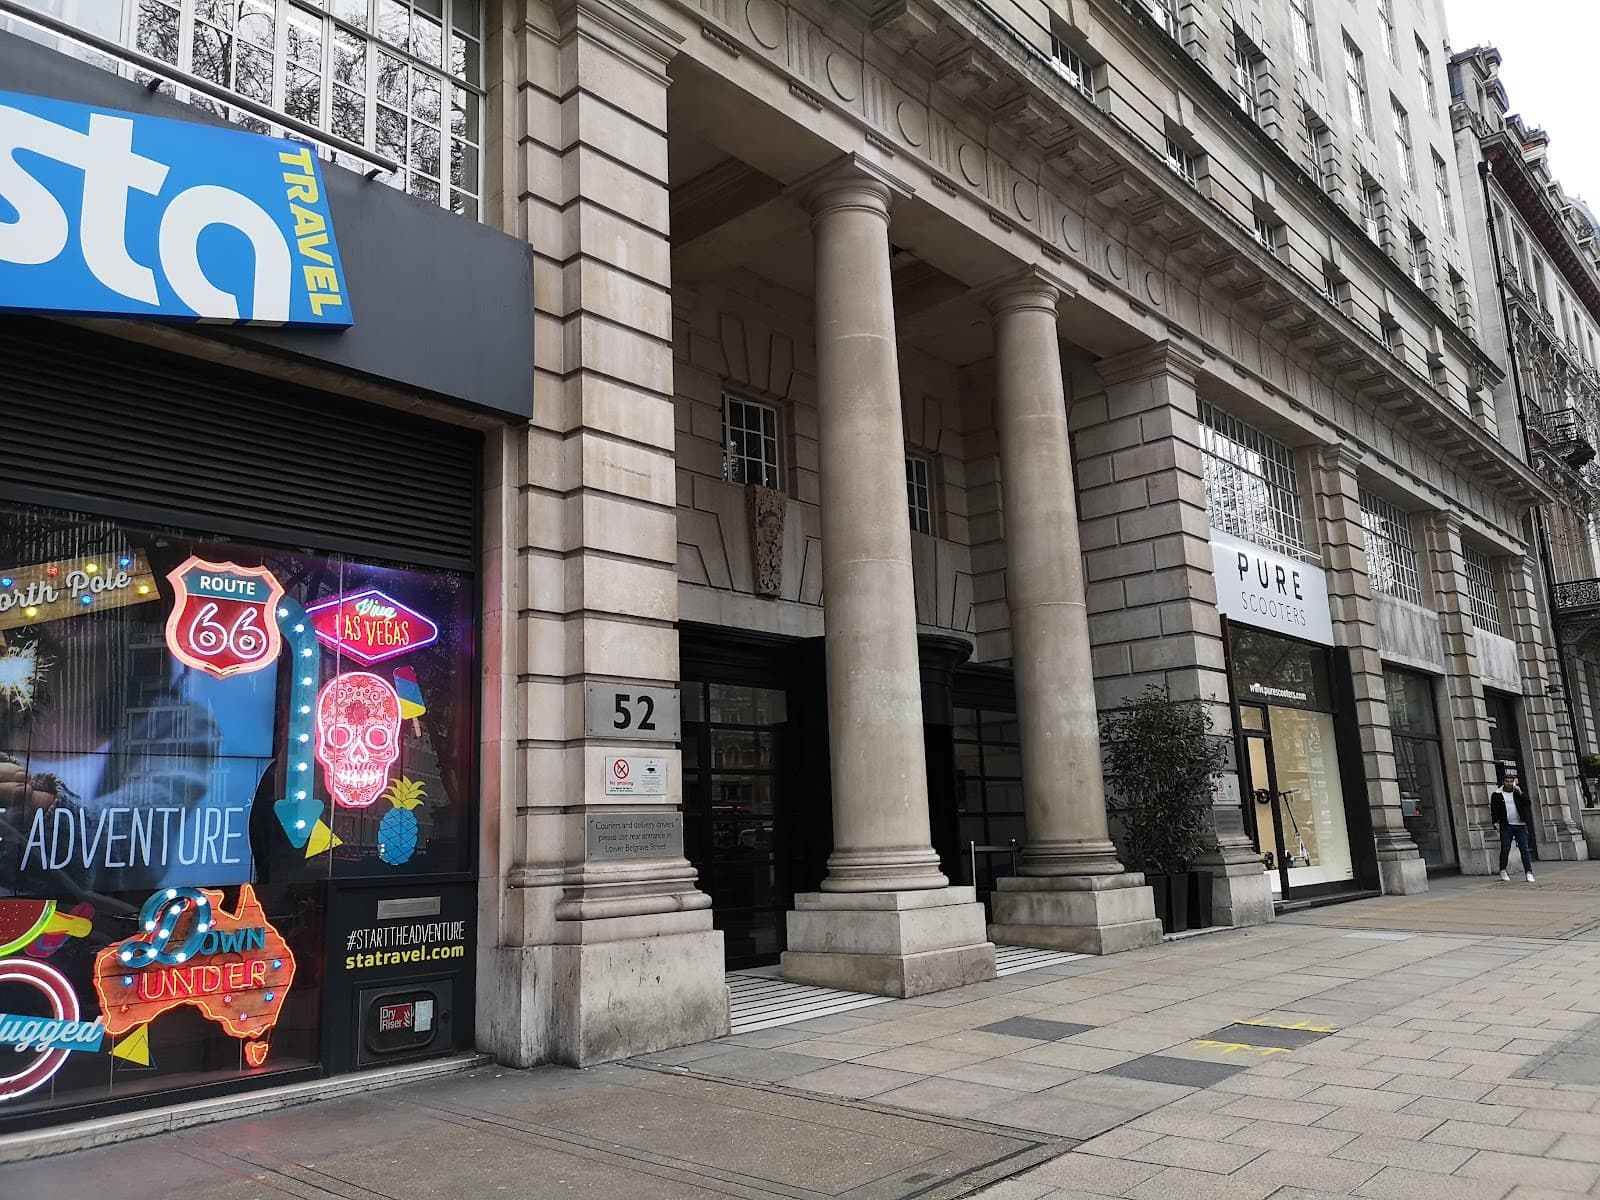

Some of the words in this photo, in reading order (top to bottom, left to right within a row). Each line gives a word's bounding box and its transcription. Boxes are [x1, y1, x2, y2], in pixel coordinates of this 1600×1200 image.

[279, 147, 343, 317] TRAVEL
[66, 567, 131, 597] Pole
[200, 575, 256, 596] ROUTE
[1237, 551, 1303, 600] PURE
[1241, 591, 1306, 626] SCOOTERS
[188, 602, 267, 659] 66
[335, 614, 362, 642] LAS
[364, 618, 409, 647] VEGAS
[1249, 682, 1307, 701] www.purescooters.com
[613, 693, 656, 731] 52
[20, 806, 244, 871] ADVENTURE
[346, 921, 466, 951] #STARTTHEADVENTURE
[345, 944, 465, 970] statravel.com
[138, 958, 268, 1001] UNDER
[382, 1008, 396, 1020] Dry
[382, 1019, 402, 1031] Riser
